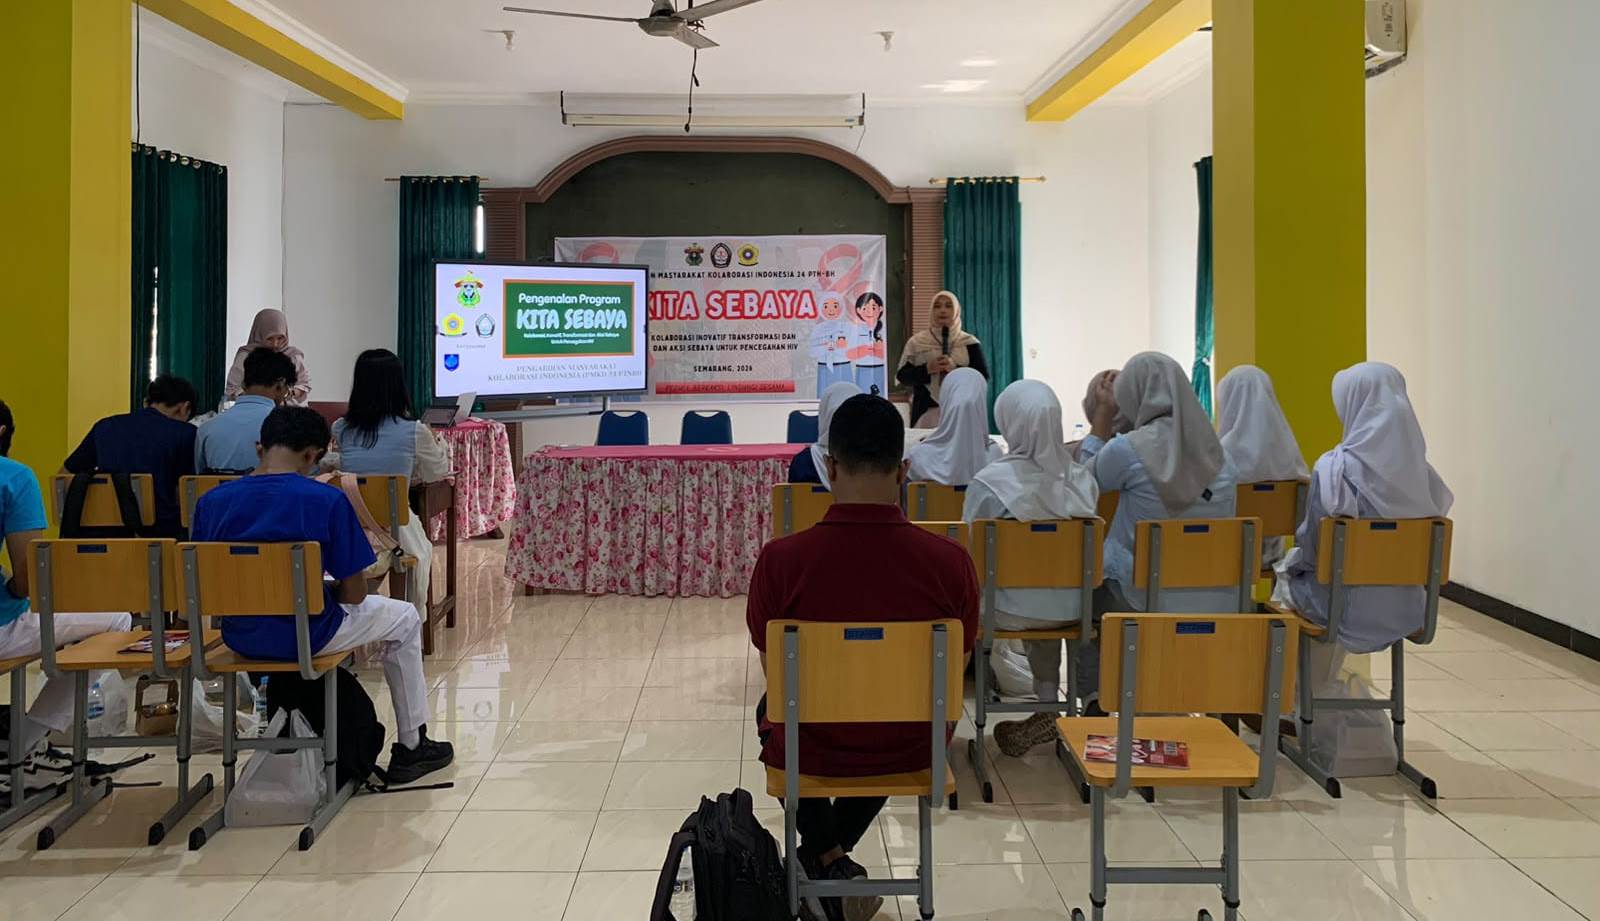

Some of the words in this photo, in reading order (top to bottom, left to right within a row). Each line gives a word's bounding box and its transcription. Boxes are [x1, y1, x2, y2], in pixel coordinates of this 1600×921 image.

[518, 293, 578, 306] Pengenalan
[579, 294, 621, 306] Program
[705, 290, 818, 320] SEBAYA
[517, 308, 560, 330] KITA
[564, 308, 628, 330] SEBAYA
